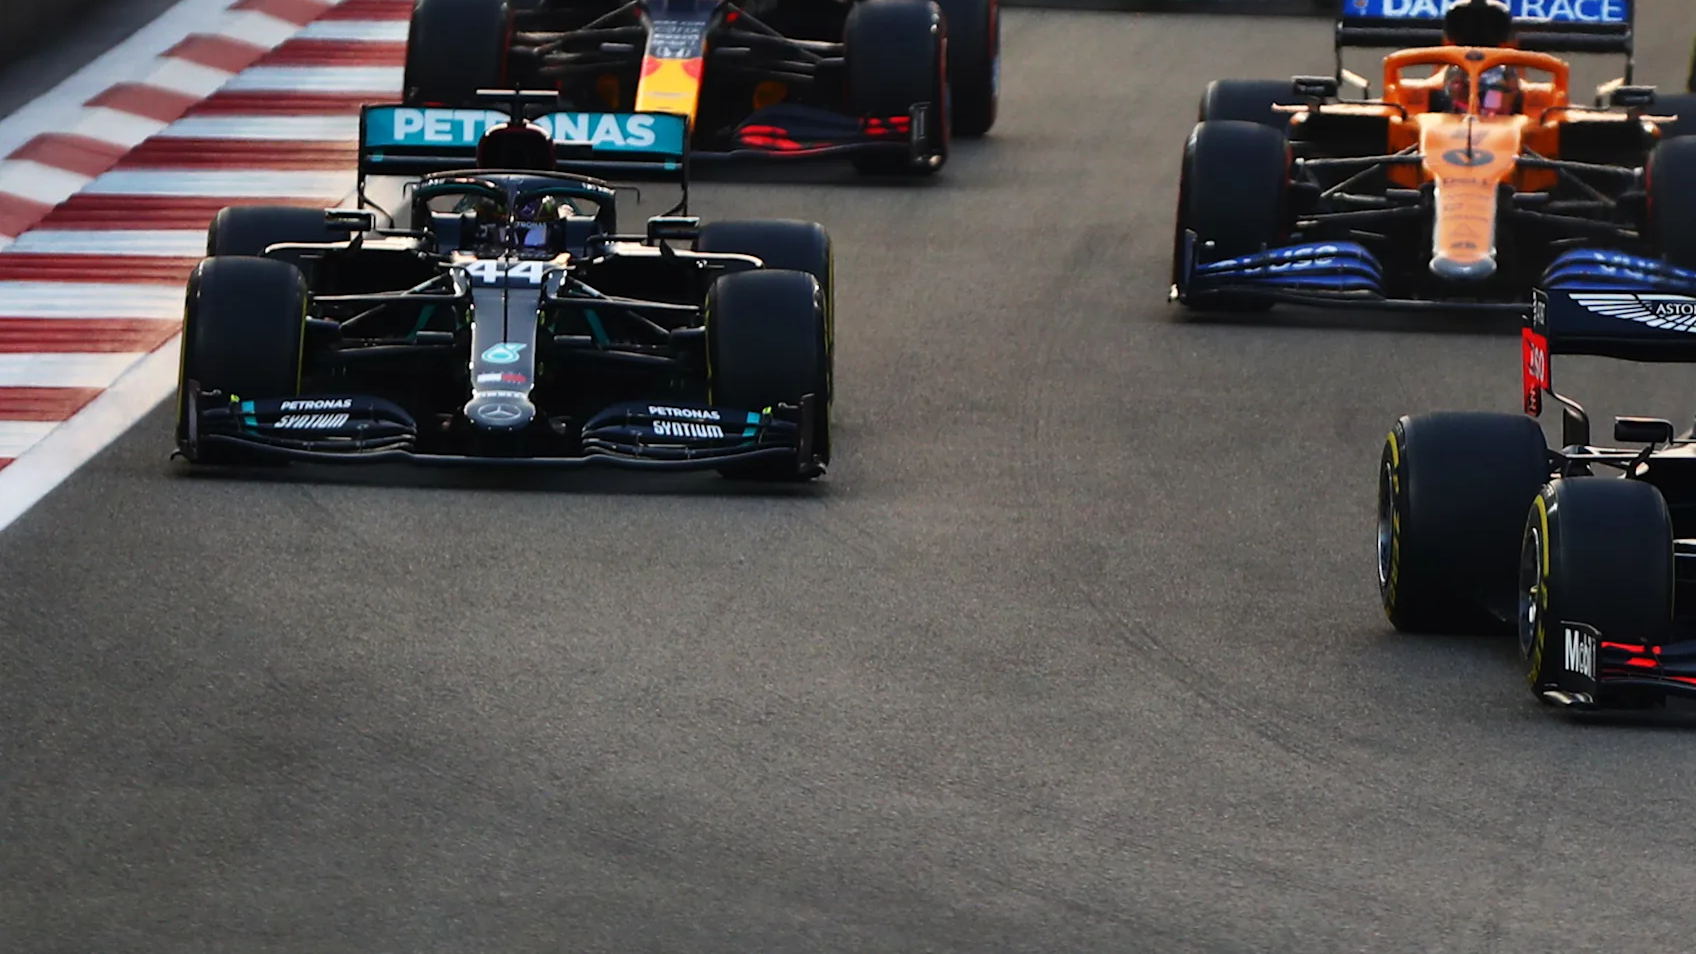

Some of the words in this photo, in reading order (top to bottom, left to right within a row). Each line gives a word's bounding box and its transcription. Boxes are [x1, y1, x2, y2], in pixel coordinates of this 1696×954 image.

[468, 259, 543, 284] 44
[281, 399, 352, 411] PETRONAS
[648, 405, 721, 420] PETRONAS
[274, 414, 349, 428] SYNTIUM
[653, 420, 724, 439] SYNTIUM
